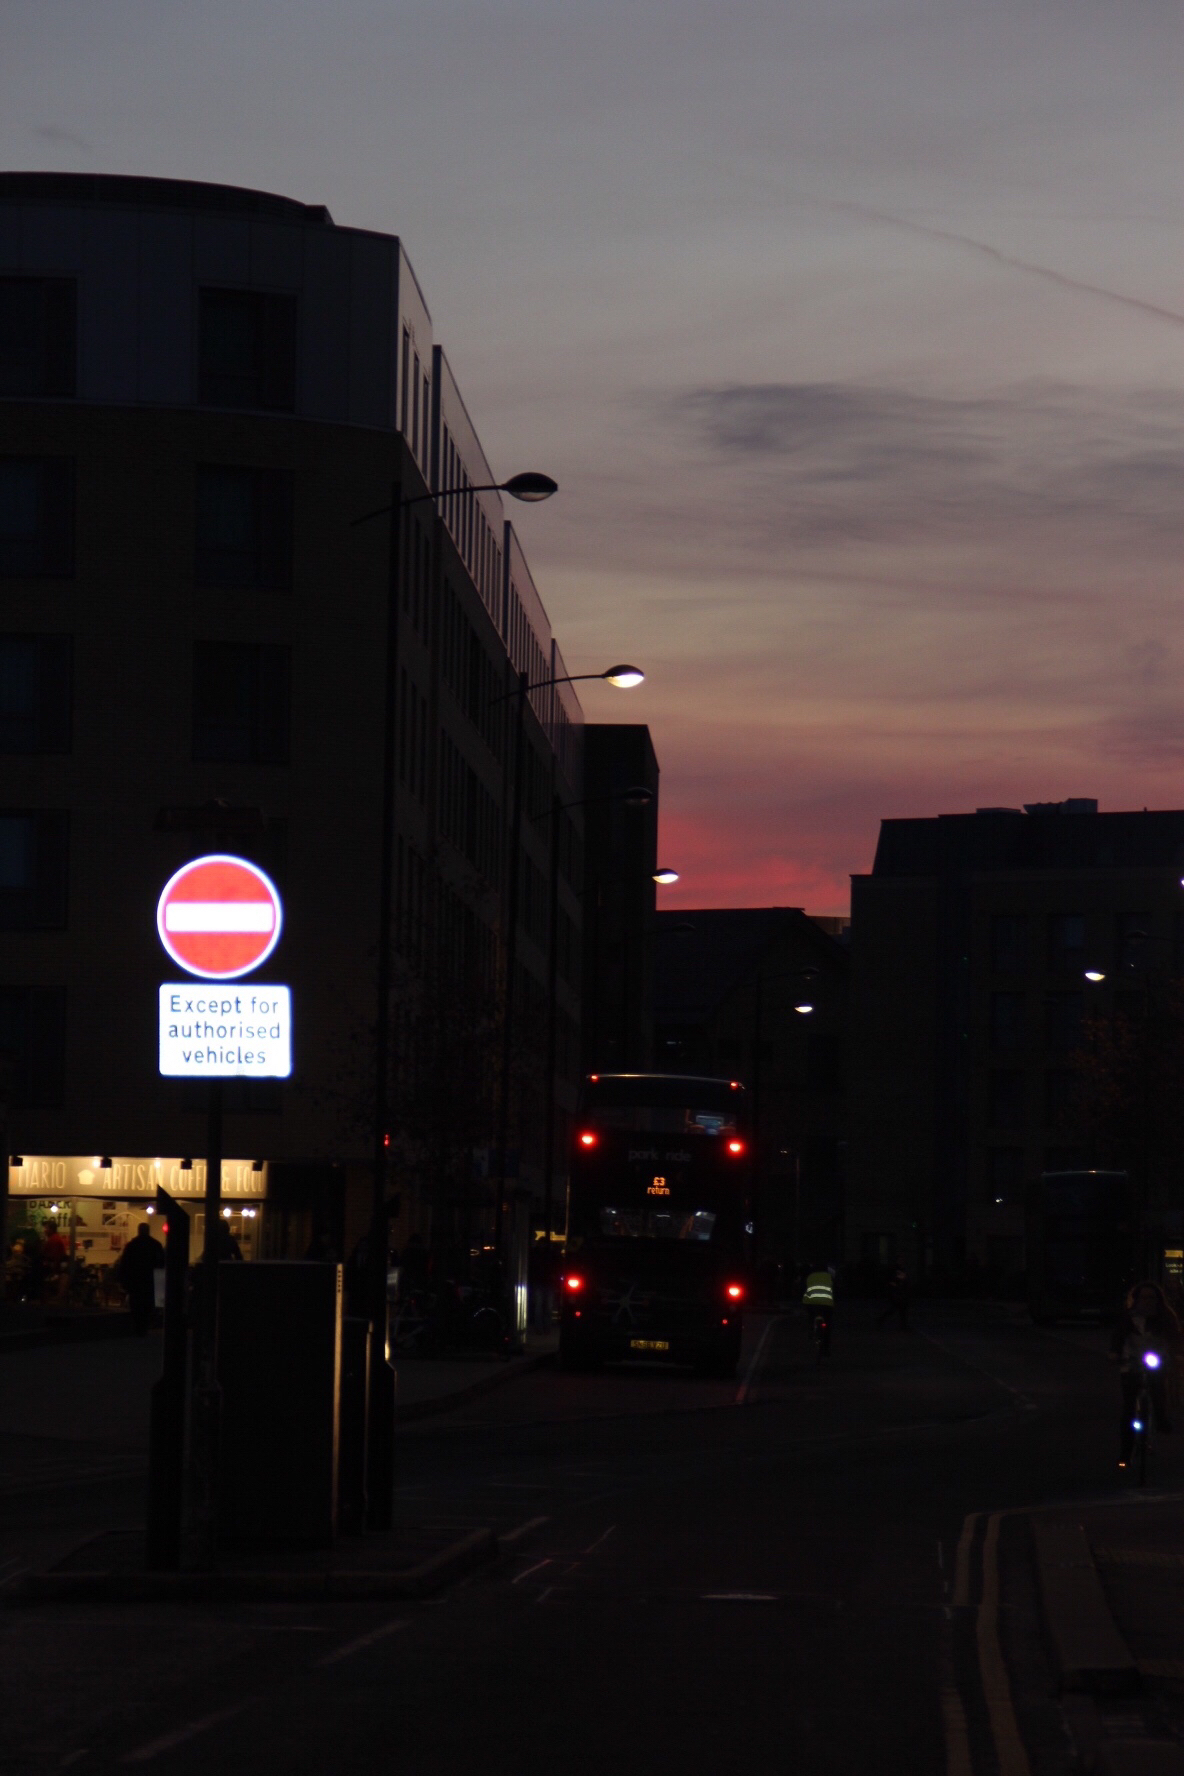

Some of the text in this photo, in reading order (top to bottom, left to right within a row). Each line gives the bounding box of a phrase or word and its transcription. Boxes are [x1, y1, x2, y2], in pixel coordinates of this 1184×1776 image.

[170, 994, 279, 1016] Except for
[168, 1020, 281, 1039] authorised
[182, 1046, 267, 1064] vehicles
[628, 1147, 659, 1163] park
[102, 1162, 164, 1191] ARTISAN
[169, 1164, 207, 1192] COFF
[653, 1176, 667, 1187] £3
[646, 1185, 671, 1196] return
